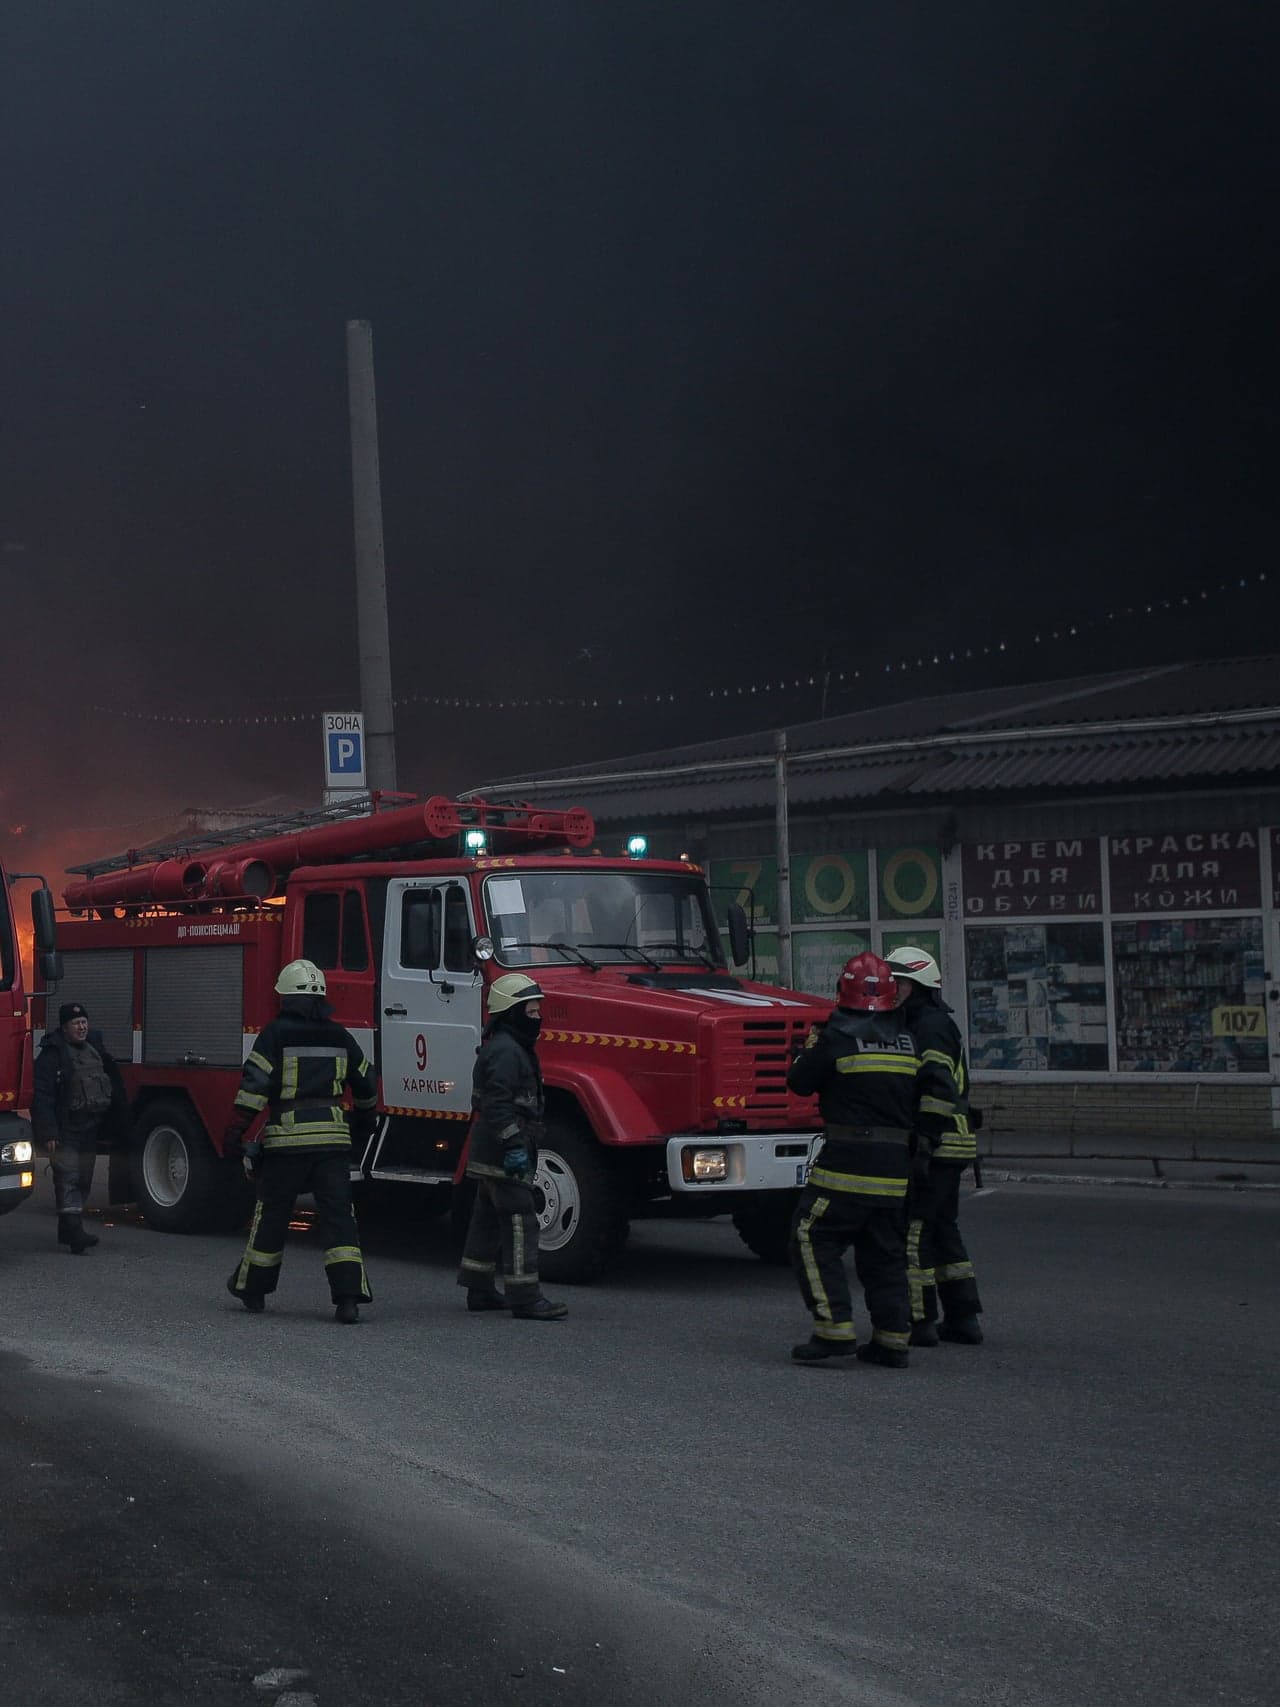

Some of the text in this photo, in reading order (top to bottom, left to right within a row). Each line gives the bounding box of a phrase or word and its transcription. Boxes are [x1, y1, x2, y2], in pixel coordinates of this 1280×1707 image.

[327, 716, 361, 730] ЗОНА
[976, 840, 1084, 861] КРЕМ
[1111, 831, 1257, 856] КРАСКА
[991, 866, 1069, 888] ДЛЯ
[1147, 860, 1220, 883] ДЛЯ
[967, 892, 1097, 913] ОБУВИ
[1133, 888, 1238, 909] КОЖИ
[1221, 1010, 1261, 1033] 107
[415, 1034, 427, 1071] 9
[402, 1078, 447, 1094] ХАРКІВ
